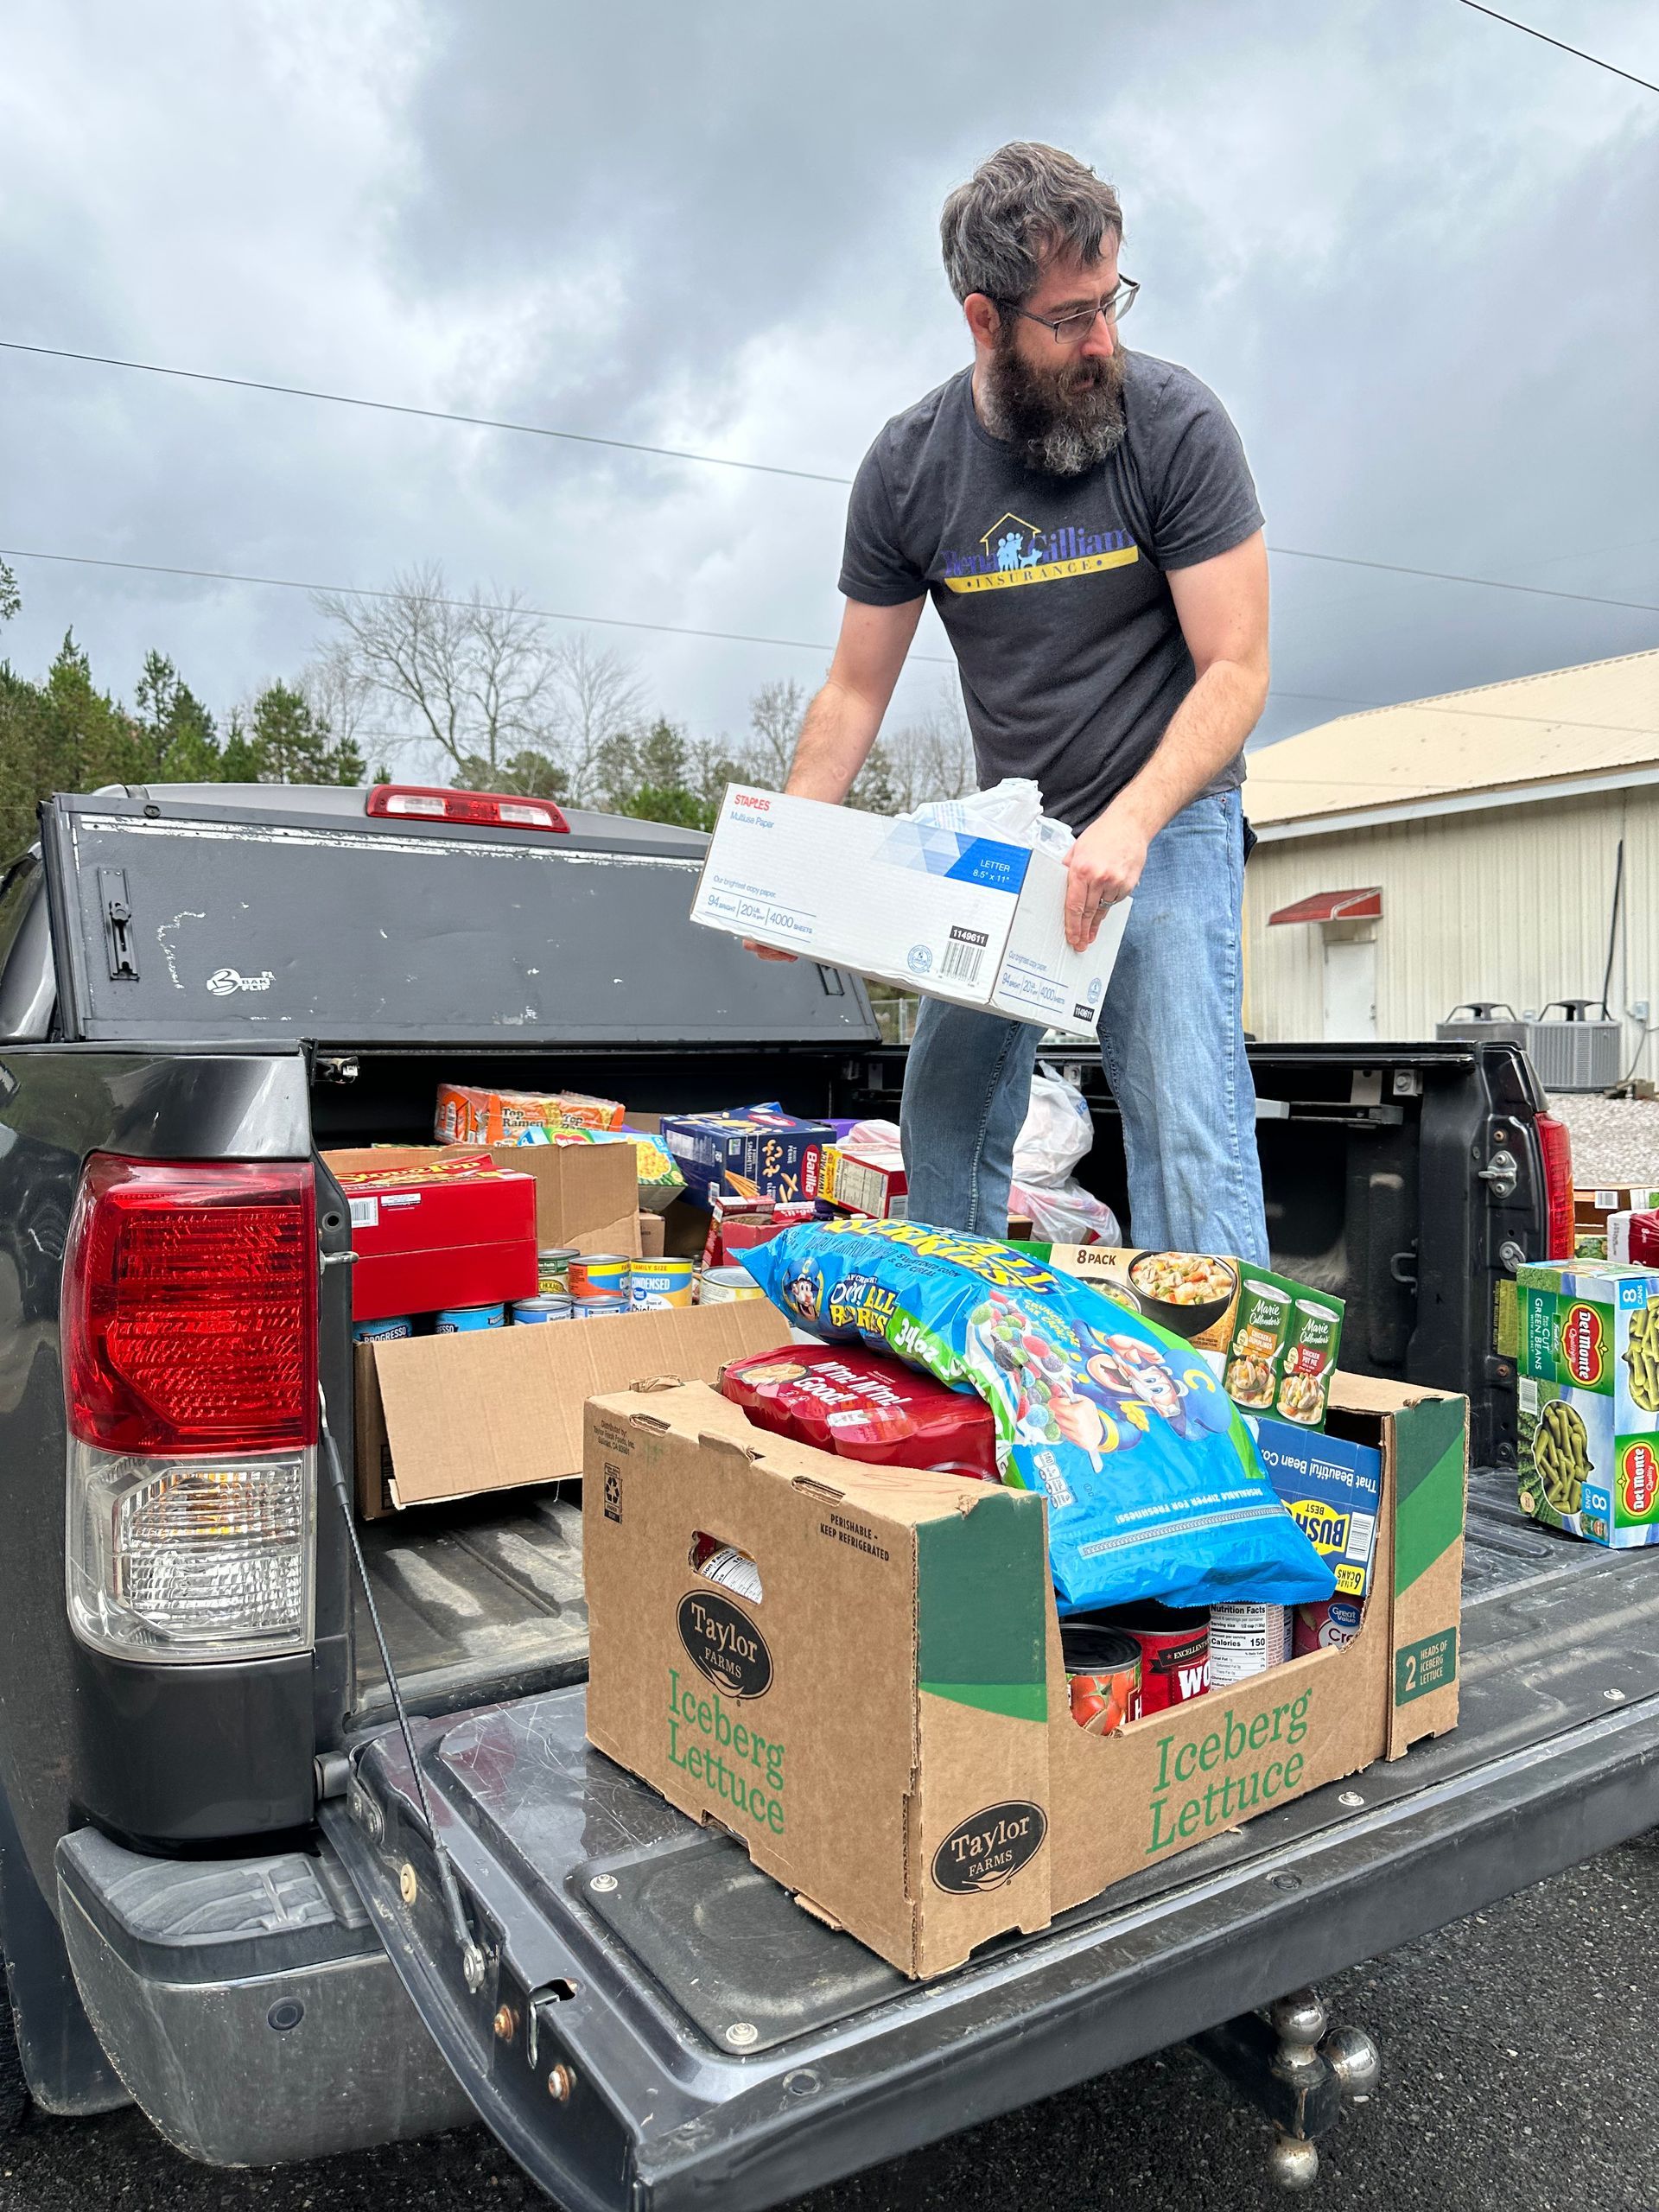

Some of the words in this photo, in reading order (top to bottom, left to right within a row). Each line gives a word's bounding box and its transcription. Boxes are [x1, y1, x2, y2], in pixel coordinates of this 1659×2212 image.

[976, 560, 1092, 588] INSURANCE
[734, 794, 771, 811] STAPLES
[730, 811, 755, 824] Multiuse
[755, 817, 774, 830] Paper
[980, 859, 1011, 873] LETTER
[714, 875, 723, 885] Our
[724, 878, 747, 892] brightest
[747, 884, 760, 894] copy
[708, 894, 720, 907] 94
[741, 904, 753, 917] 20
[770, 912, 794, 928] 4000
[793, 924, 812, 934] SHEETS
[953, 929, 985, 944] 1149611
[502, 1108, 524, 1120] Top
[502, 1118, 543, 1128] Ramen
[563, 1114, 583, 1126] Top
[654, 1137, 664, 1147] 8
[805, 1151, 818, 1194] Barilla
[1077, 1249, 1087, 1264] 8
[1088, 1254, 1117, 1266] PACK
[938, 1268, 962, 1278] CORN
[631, 1277, 671, 1290] CONDENSED
[863, 1285, 896, 1315] ALL
[1623, 1288, 1637, 1303] 8
[1251, 1299, 1280, 1316] Marie
[1535, 1298, 1543, 1332] GREEN
[1249, 1313, 1281, 1326] Callender's
[1302, 1318, 1329, 1333] Marie
[1579, 1312, 1591, 1333] Del
[1300, 1332, 1330, 1344] Callender's
[1568, 1327, 1577, 1356] Quality
[1578, 1336, 1591, 1380] Monte
[1261, 1449, 1279, 1466] Co.
[1281, 1455, 1308, 1475] Bean
[1309, 1462, 1354, 1487] Beautiful
[1632, 1447, 1644, 1488] Monte
[1355, 1475, 1377, 1493] That
[1646, 1465, 1655, 1491] Quality
[1592, 1494, 1607, 1511] 8
[1633, 1489, 1645, 1510] Del
[1305, 1504, 1325, 1515] BEST
[830, 1514, 872, 1540] PERISHABLE
[820, 1523, 836, 1538] KEEP
[839, 1531, 889, 1561] REFRIGERATED
[1337, 1569, 1355, 1581] CANS
[1354, 1573, 1362, 1590] 6
[1211, 1605, 1244, 1614] Nutrition
[1247, 1605, 1266, 1614] Facts
[1332, 1607, 1356, 1618] Great
[1338, 1615, 1356, 1624] Value
[691, 1602, 758, 1663] Taylor
[1211, 1638, 1241, 1647] Calories
[1250, 1638, 1266, 1647] 150
[1420, 1643, 1440, 1660] HEADS
[1440, 1640, 1448, 1652] OF
[704, 1646, 741, 1679] FARMS
[1420, 1655, 1444, 1673] ICEBERG
[1405, 1655, 1416, 1691] 2
[1420, 1666, 1443, 1685] LETTUCE
[669, 1668, 785, 1791] Iceberg
[1152, 1688, 1313, 1794] Iceberg
[668, 1719, 785, 1834] Lettuce
[1145, 1751, 1306, 1855] Lettuce
[950, 1816, 1032, 1865] Taylor
[969, 1847, 1014, 1878] FARMS
